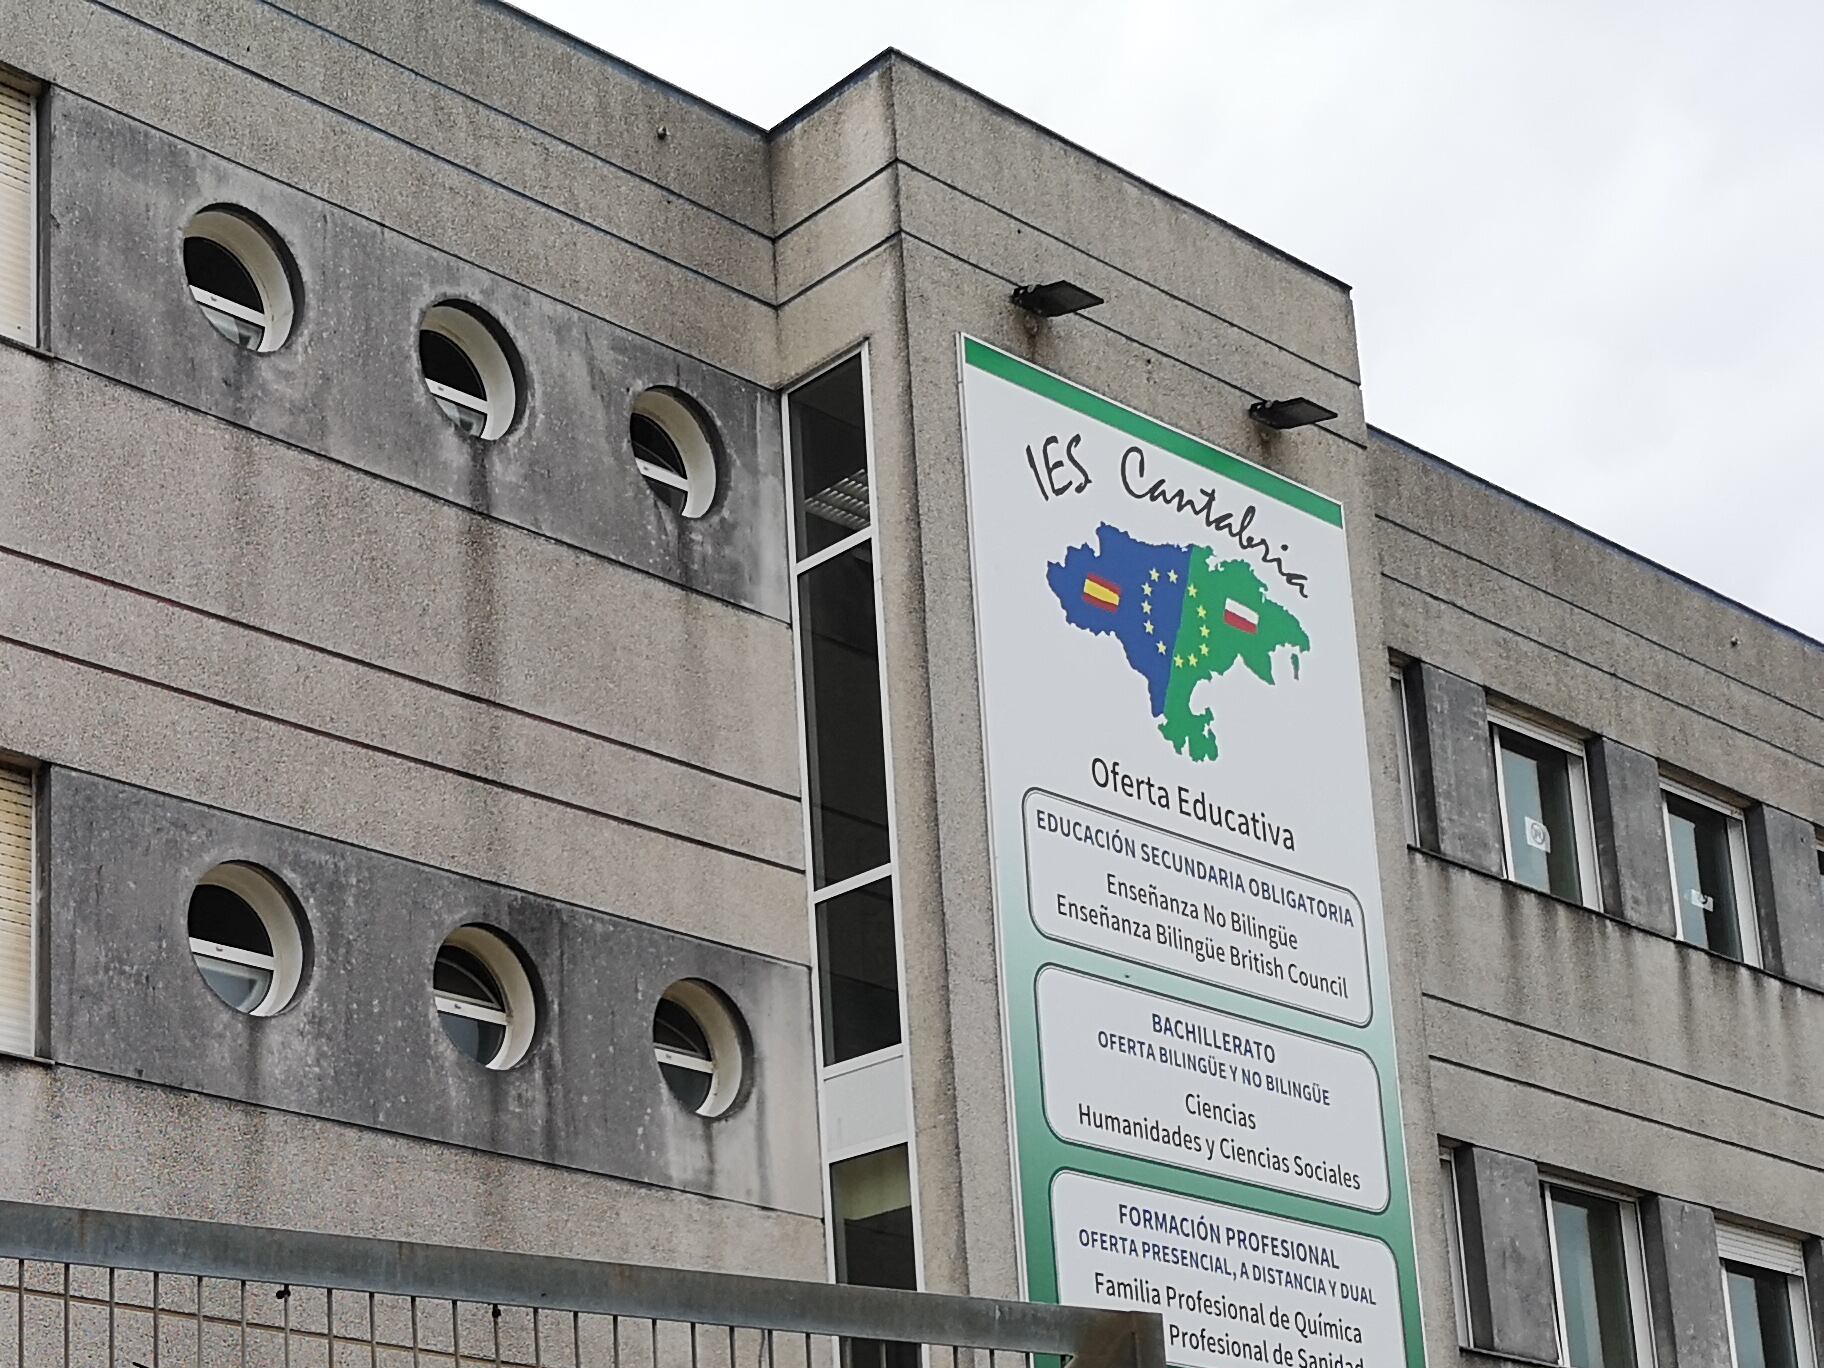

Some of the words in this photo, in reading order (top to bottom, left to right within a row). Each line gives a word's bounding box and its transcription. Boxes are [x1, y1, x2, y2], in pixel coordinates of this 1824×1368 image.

[1025, 433, 1092, 501] IES
[1120, 446, 1309, 599] Cantabria
[1091, 757, 1171, 811] Oferta
[1178, 786, 1296, 852] Educativa
[1036, 810, 1137, 860] EDUCACIÓN
[1140, 843, 1246, 894] SECUNDARIA
[1248, 878, 1355, 928] OBLIGATORIA
[1057, 893, 1152, 942] Enseñanza
[1156, 919, 1226, 963] Bilingüe
[1229, 945, 1285, 982] British
[1287, 963, 1349, 1000] Council
[1106, 873, 1199, 921] Enseñanza
[1204, 903, 1227, 929] No
[1231, 910, 1298, 952] Bilingüe
[1097, 1031, 1156, 1062] OFERTA
[1159, 1047, 1227, 1080] BILINGÜE
[1230, 1065, 1239, 1083] Y
[1241, 1067, 1263, 1089] NO
[1266, 1074, 1331, 1107] BILINGÜE
[1151, 1013, 1276, 1064] BACHILLERATO
[1078, 1103, 1203, 1154] Humanidades
[1206, 1139, 1216, 1160] y
[1219, 1138, 1290, 1174] Ciencias
[1294, 1155, 1361, 1191] Sociales
[1185, 1093, 1257, 1130] Ciencias
[1078, 1228, 1139, 1258] OFERTA
[1142, 1242, 1237, 1281] PRESENCIAL,
[1240, 1262, 1250, 1280] A
[1252, 1264, 1325, 1296] DISTANCIA
[1328, 1279, 1337, 1297] Y
[1340, 1282, 1376, 1306] DUAL
[1118, 1203, 1222, 1244] FORMACIÓN
[1225, 1227, 1340, 1270] PROFESIONAL
[1094, 1272, 1161, 1305] Familia
[1166, 1285, 1266, 1328] Profesional
[1269, 1306, 1290, 1330] de
[1294, 1313, 1362, 1344] Química
[1169, 1324, 1269, 1364] Profesional
[1273, 1345, 1294, 1368] de
